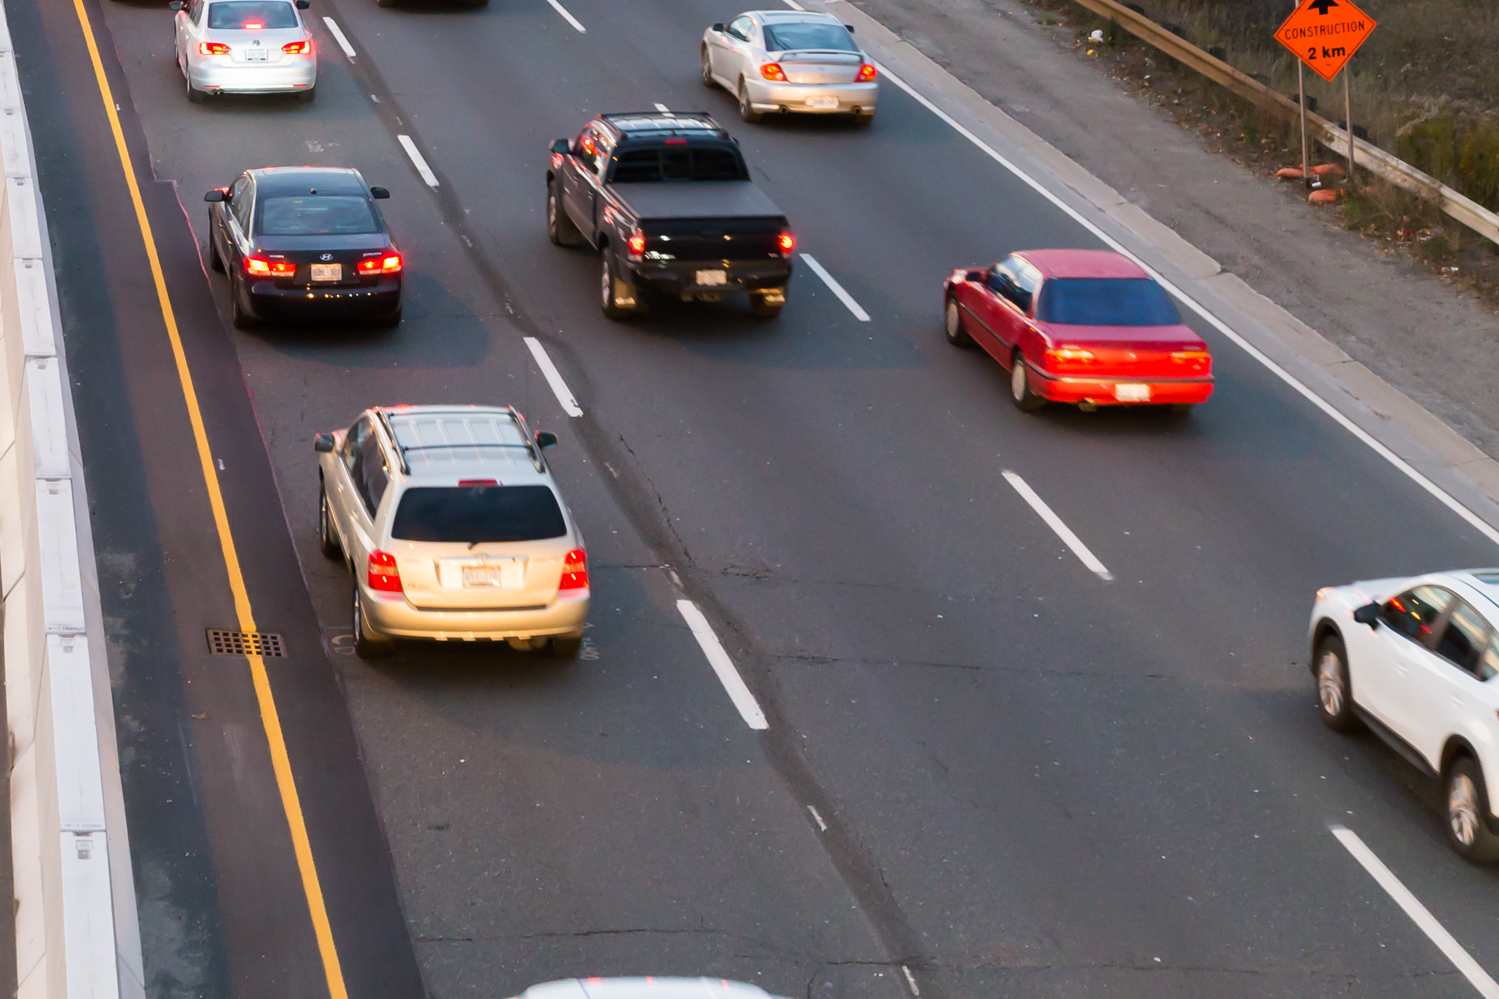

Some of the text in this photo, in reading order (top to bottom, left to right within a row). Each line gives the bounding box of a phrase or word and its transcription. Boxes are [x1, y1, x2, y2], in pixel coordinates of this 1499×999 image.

[1284, 20, 1365, 40] CONSTRUCTION
[1307, 46, 1346, 60] 2 km
